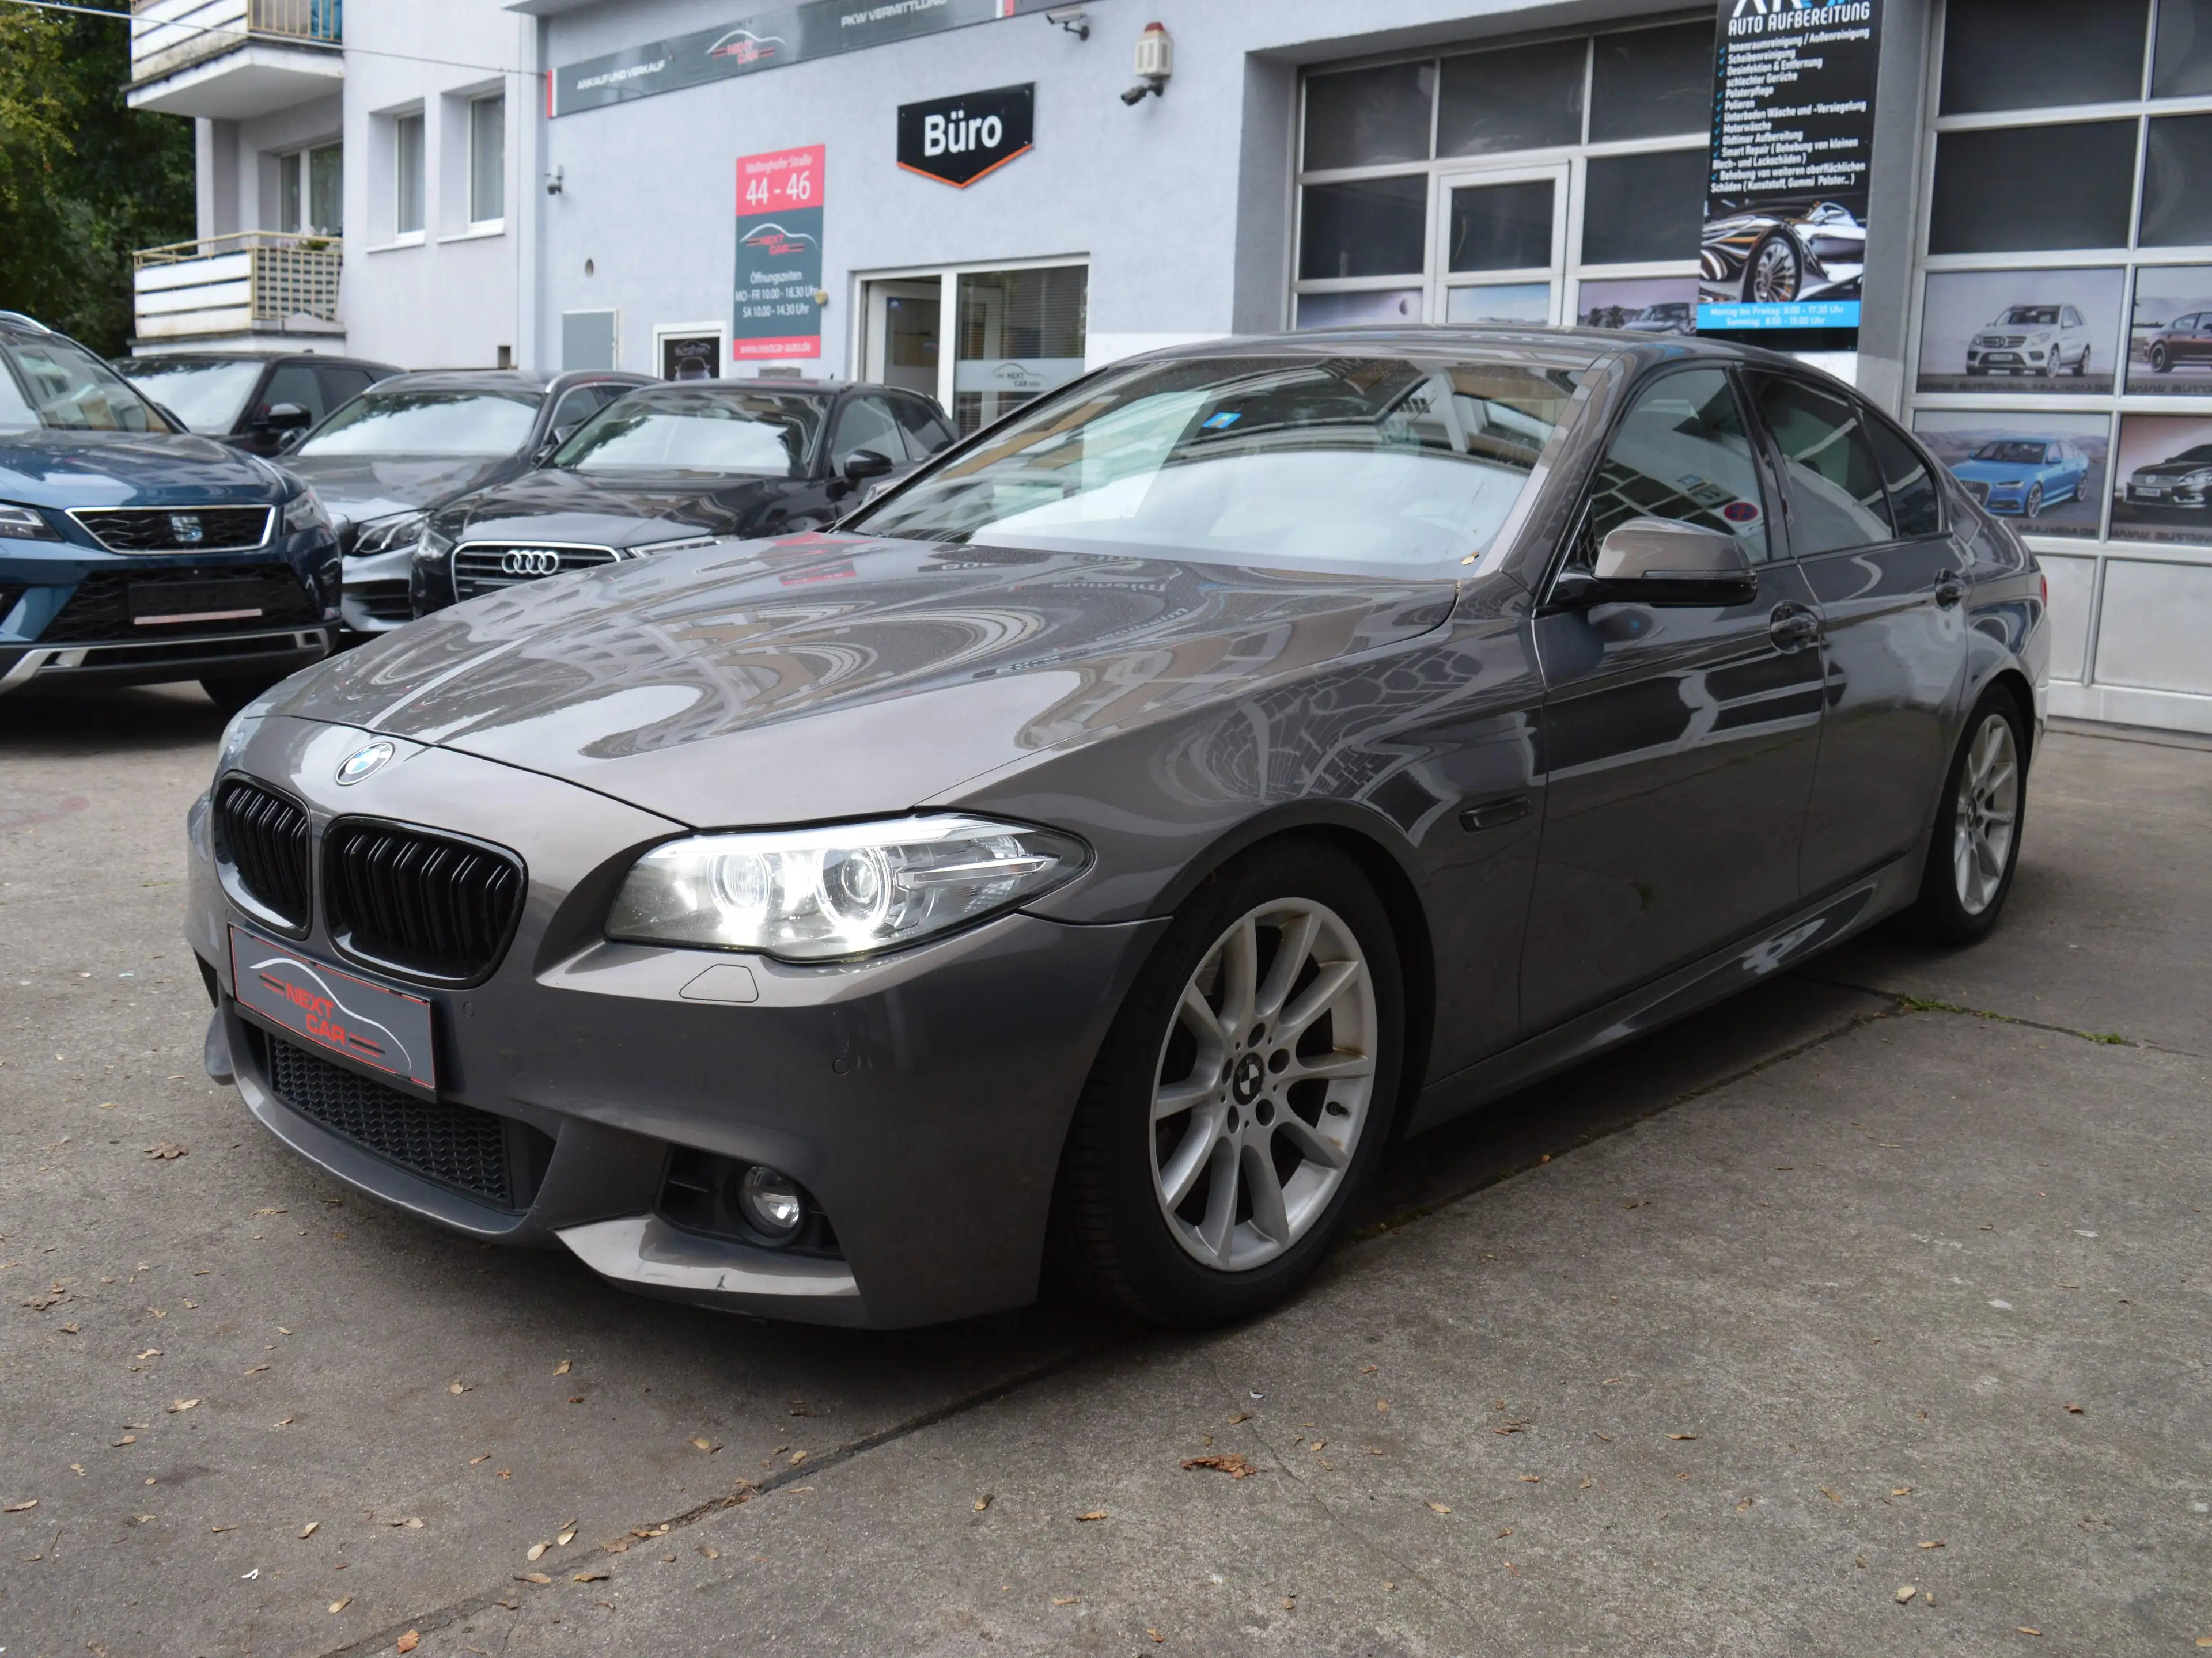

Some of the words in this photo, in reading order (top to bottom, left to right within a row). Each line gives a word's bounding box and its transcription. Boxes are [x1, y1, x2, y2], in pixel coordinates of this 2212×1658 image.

[841, 12, 866, 28] PKW
[1728, 16, 1763, 36] AUTO
[1768, 2, 1870, 31] AUFBEREITUNG
[1728, 36, 1802, 53] Innenraumreinigung
[1803, 32, 1809, 45] /
[1809, 28, 1870, 44] Außenreinigung
[737, 50, 759, 65] CAR
[1728, 48, 1796, 65] Scheibenreinigung
[577, 74, 608, 90] ANKAUF
[609, 69, 626, 82] UND
[627, 60, 665, 78] VERKAUF
[1727, 62, 1772, 77] Desinfektion
[1781, 58, 1823, 70] Entfernung
[1726, 75, 1765, 88] schlechter
[1766, 71, 1798, 84] Gerüche
[1724, 99, 1755, 111] Polieren
[1767, 106, 1796, 118] Wäsche
[1797, 104, 1812, 115] und
[925, 109, 1002, 157] Büro
[1723, 120, 1772, 134] Motorwäsche
[1755, 130, 1803, 143] Aufbereitung
[1721, 146, 1744, 158] Smart
[1745, 145, 1770, 158] Repair
[1814, 141, 1828, 150] von
[1830, 137, 1858, 149] kleinen
[1738, 156, 1752, 168] und
[1757, 169, 1771, 178] von
[1772, 166, 1805, 177] weiteren
[746, 177, 768, 206] 44
[786, 171, 810, 200] 46
[1710, 181, 1742, 194] Schäden
[750, 270, 802, 284] Öffnungszeiten
[735, 290, 747, 301] MO
[751, 289, 761, 300] FR
[762, 288, 779, 300] 10.00
[743, 306, 752, 318] SA
[753, 305, 771, 317] 10.00
[777, 303, 794, 316] 14.30
[796, 302, 809, 314] Uhr
[1711, 307, 1737, 317] Montag
[1830, 304, 1844, 314] Uhr
[286, 982, 335, 1019] NEXT
[305, 1014, 347, 1047] CAR
